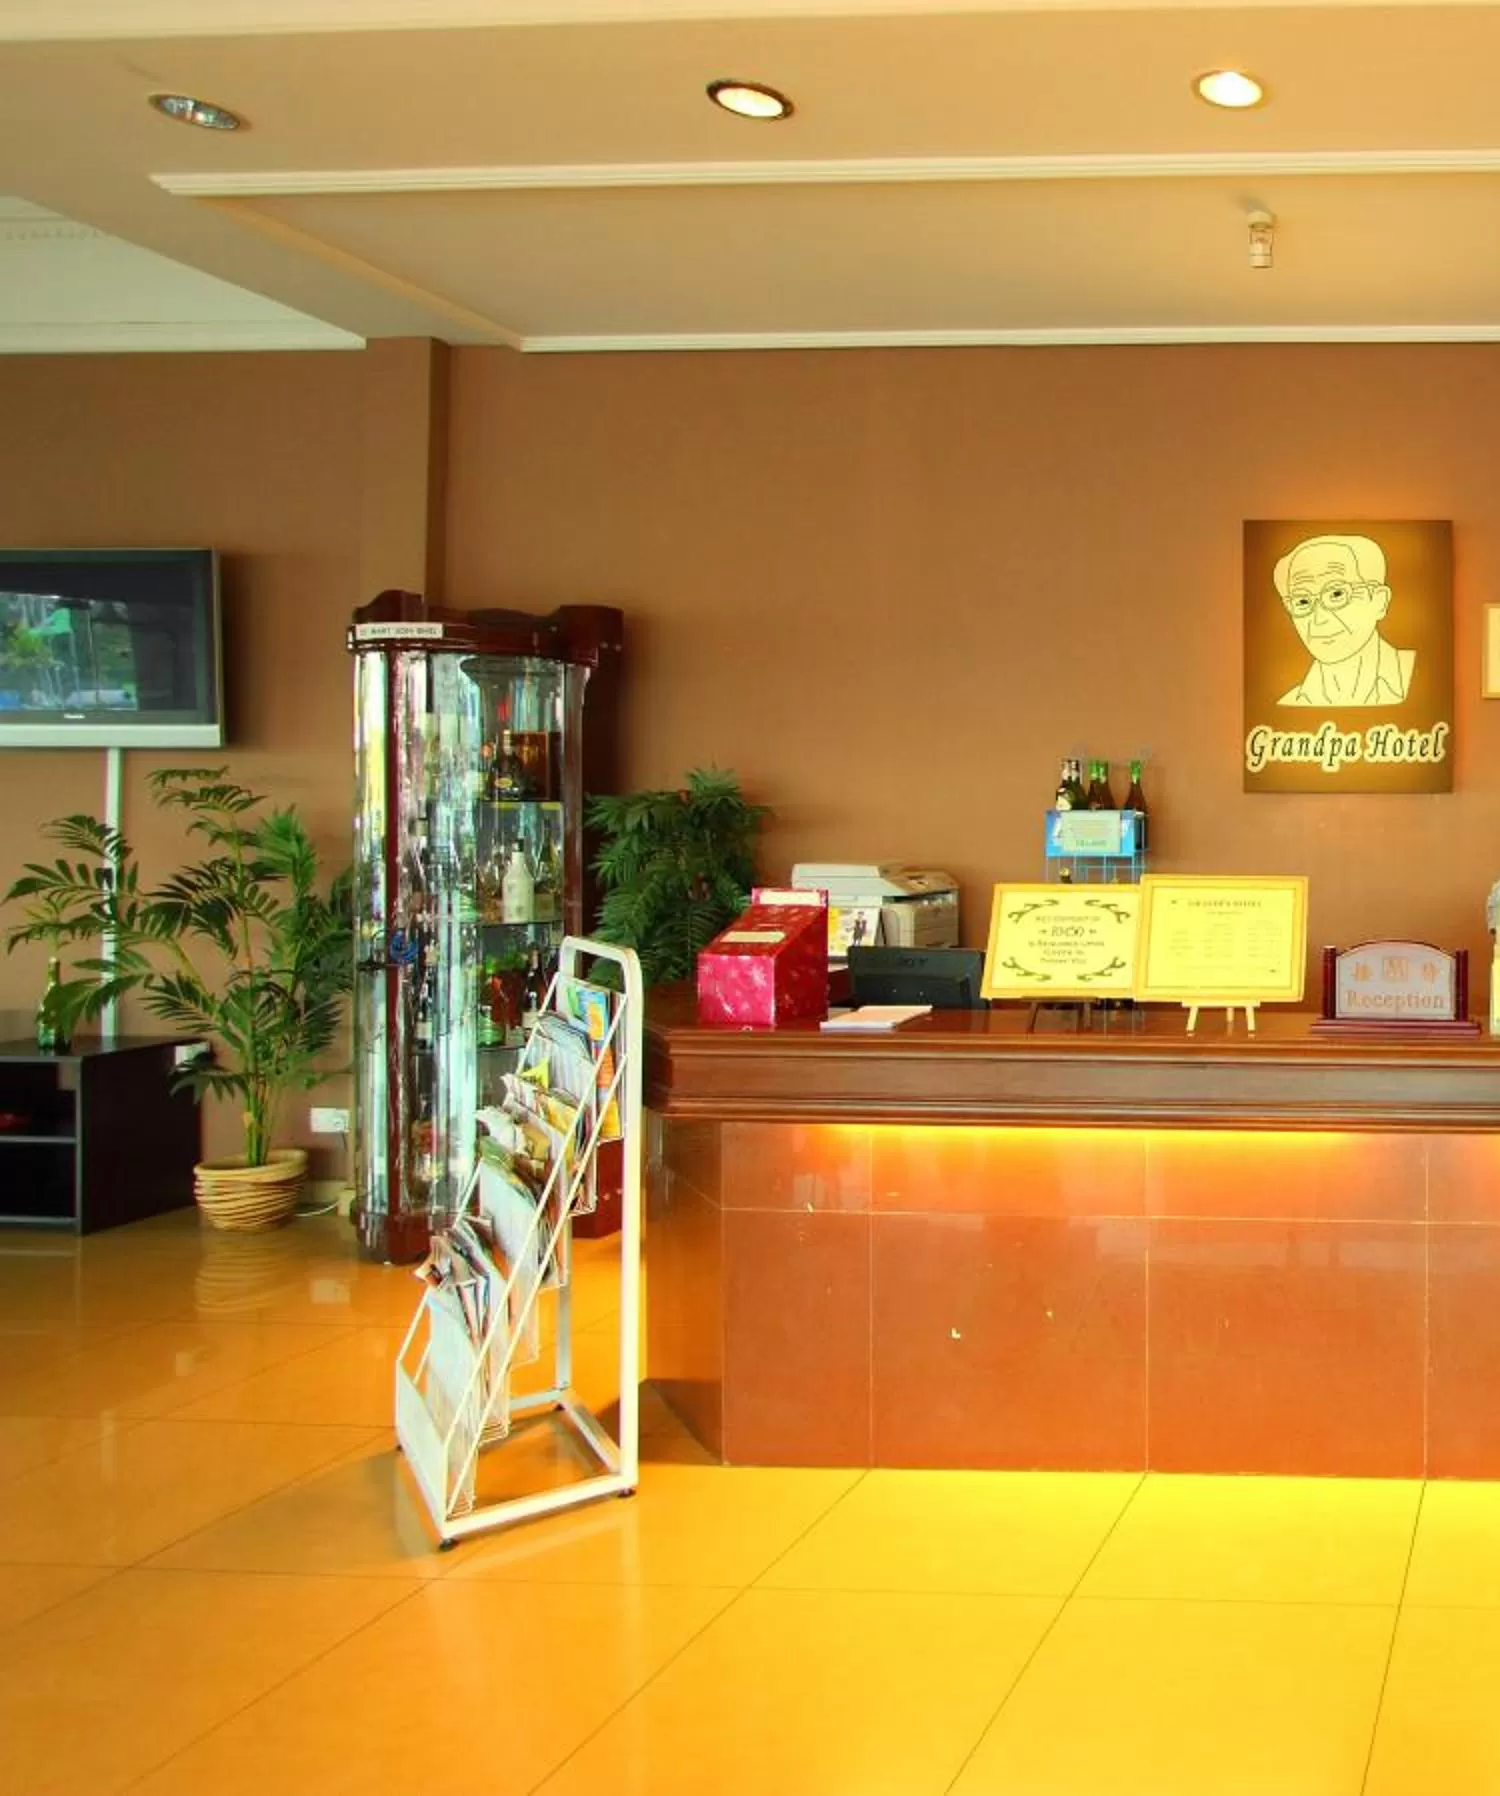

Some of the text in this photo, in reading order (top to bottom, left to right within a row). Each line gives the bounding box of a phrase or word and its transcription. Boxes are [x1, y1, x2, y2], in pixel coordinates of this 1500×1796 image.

[1249, 724, 1446, 768] Grandpa Hotel
[1345, 989, 1444, 1012] Reception
